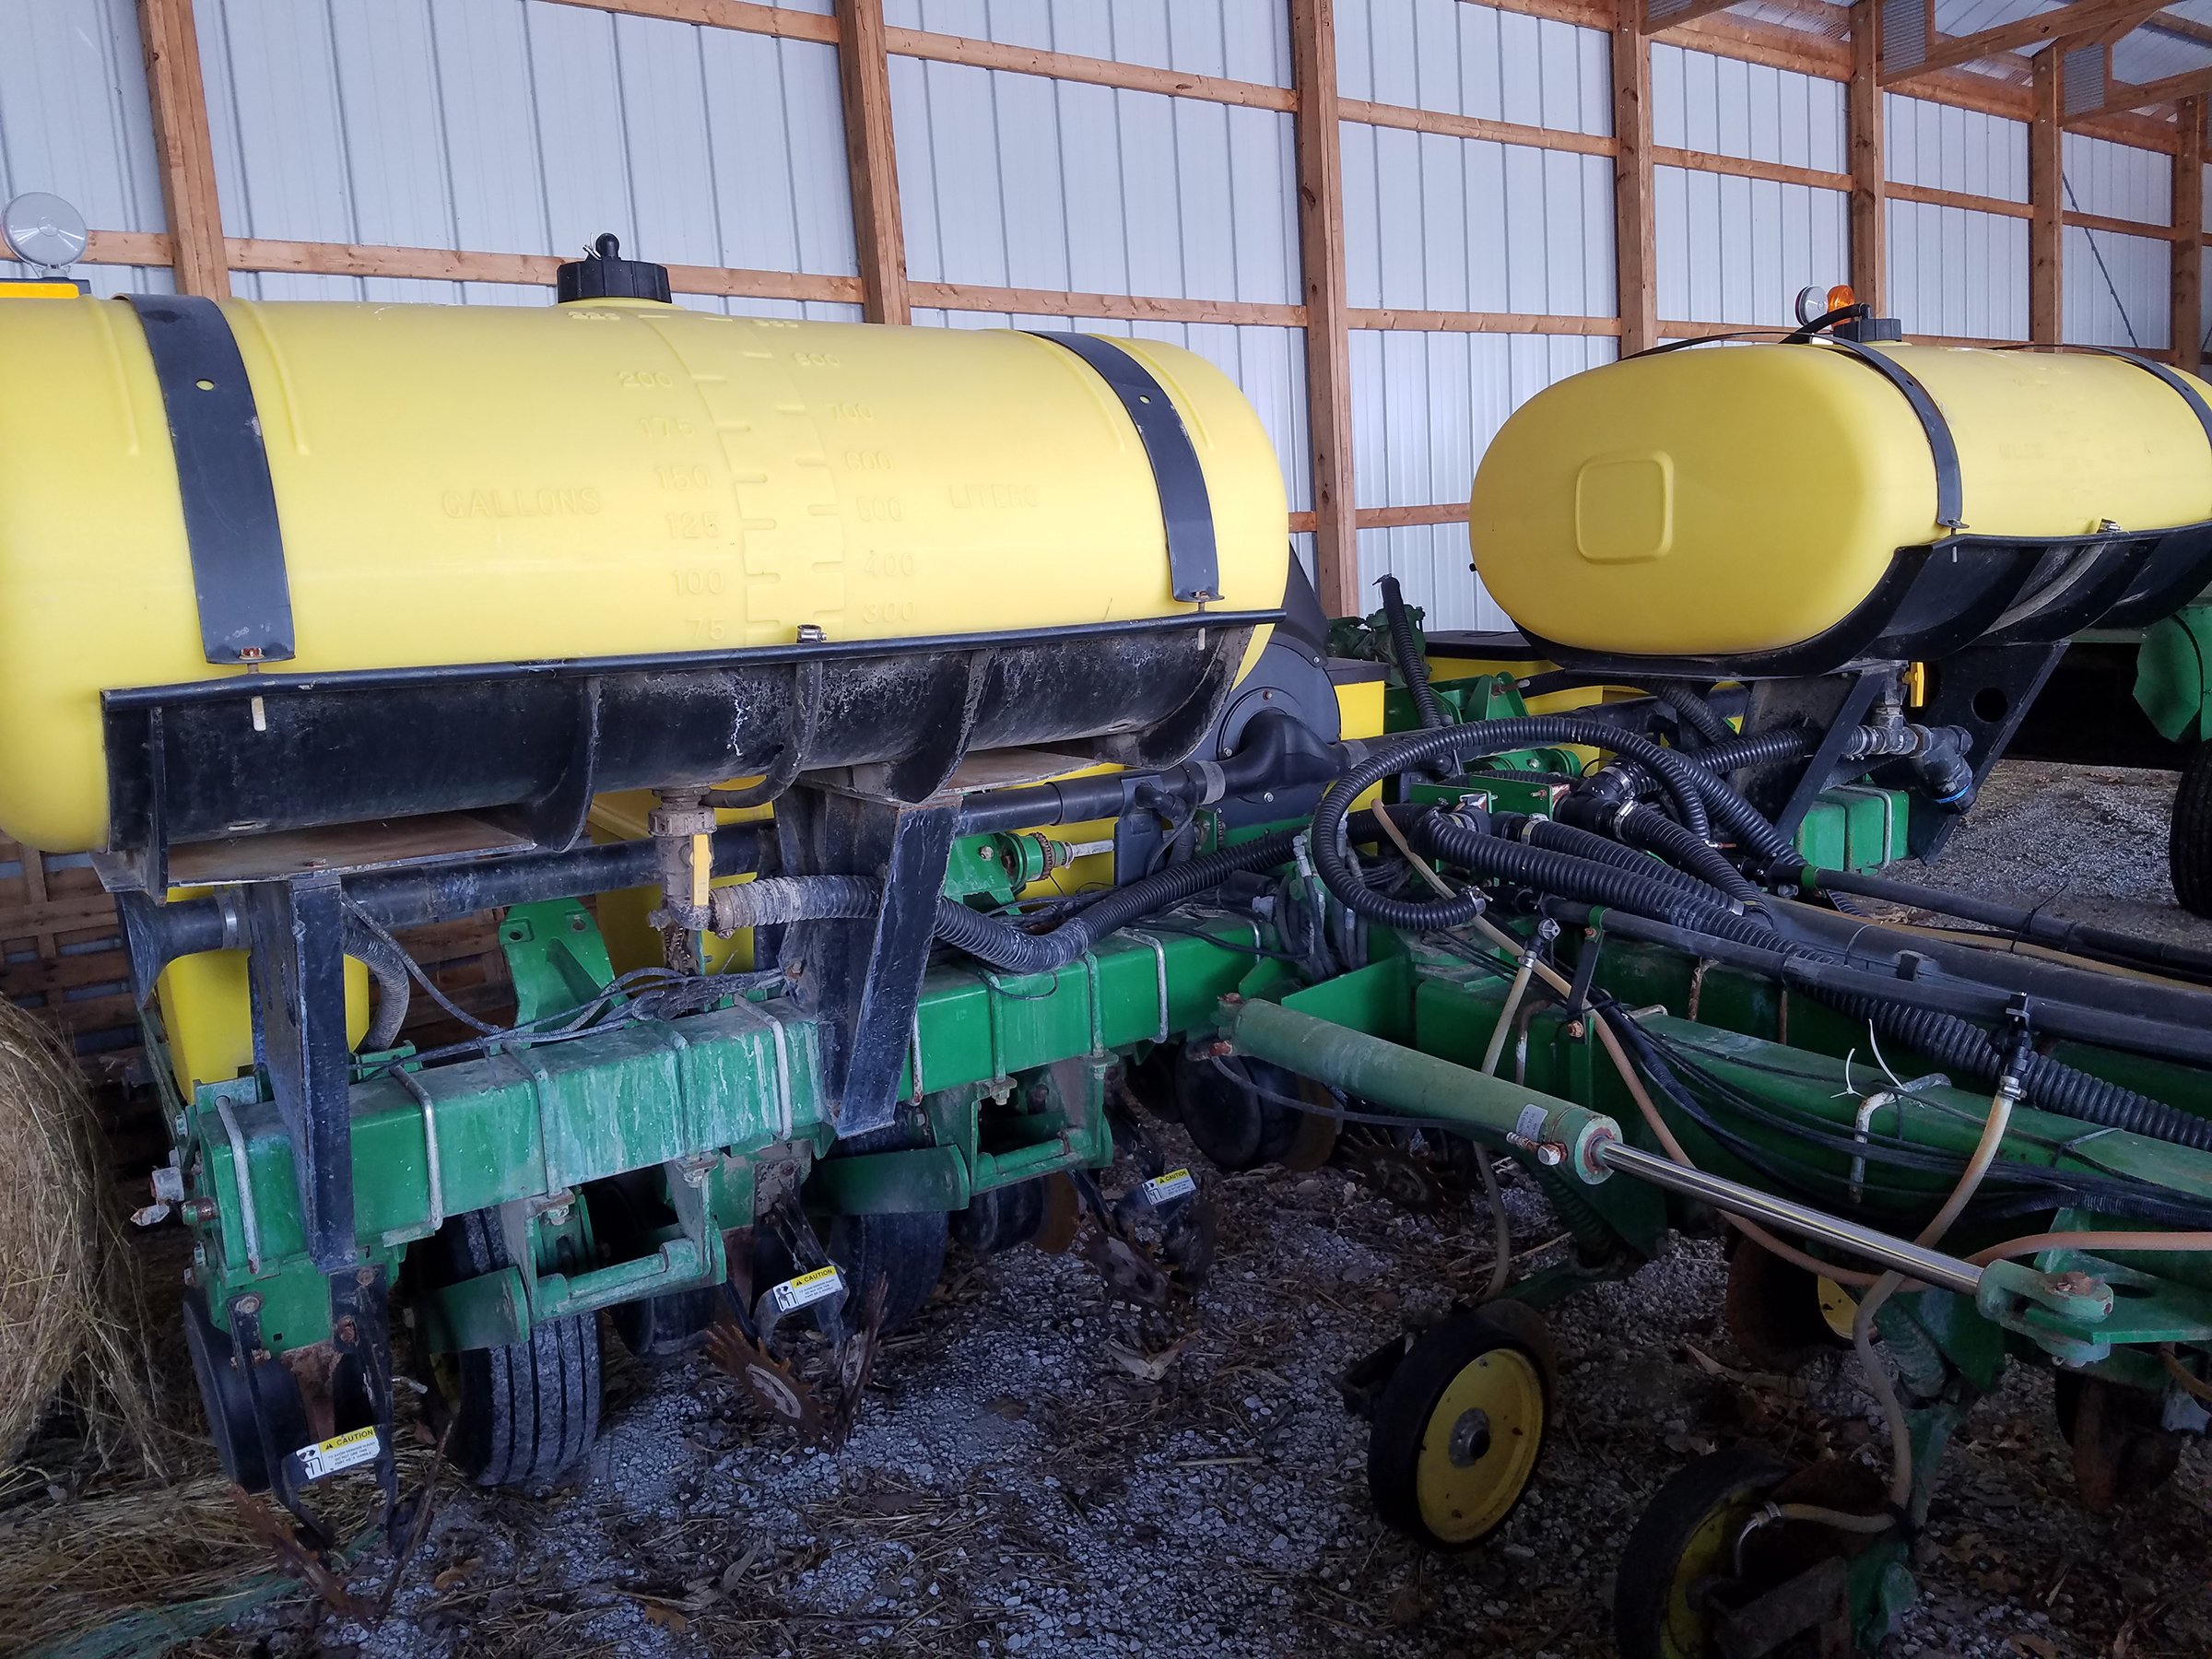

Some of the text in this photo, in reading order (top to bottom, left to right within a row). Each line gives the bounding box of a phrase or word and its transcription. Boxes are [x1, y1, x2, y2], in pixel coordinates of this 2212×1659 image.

[618, 371, 673, 389] 200
[824, 403, 876, 421] 700
[638, 417, 695, 437] 175
[845, 451, 895, 472] 600
[655, 465, 712, 489] 150
[441, 488, 601, 518] GALLONS
[948, 484, 1040, 510] LITERS
[855, 496, 904, 523] 500
[665, 511, 723, 538] 125
[864, 551, 917, 576] 400
[673, 569, 725, 594] 100
[862, 599, 917, 623] 300
[686, 618, 725, 641] 75
[1165, 1171, 1187, 1182] CAUTION
[804, 1269, 833, 1283] CAUTION
[336, 1430, 373, 1446] CAUTION
